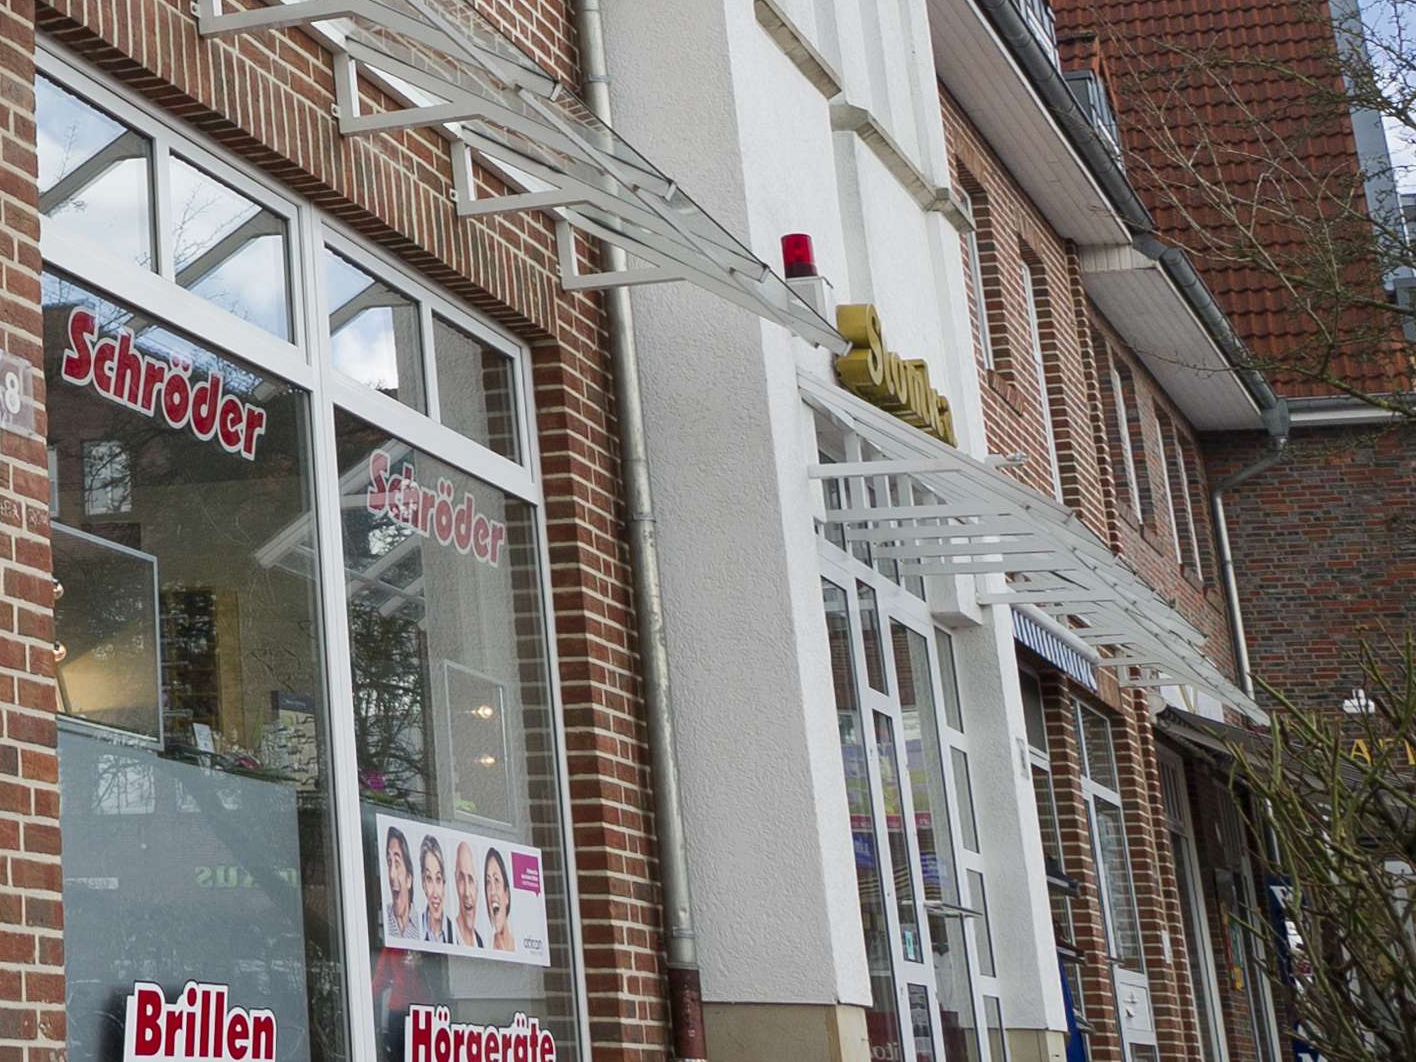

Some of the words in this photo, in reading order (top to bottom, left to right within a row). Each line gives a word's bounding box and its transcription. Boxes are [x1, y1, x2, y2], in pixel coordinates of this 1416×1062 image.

[62, 307, 266, 459] Schröder
[368, 450, 506, 567] Schröder
[134, 987, 276, 1060] Brillen
